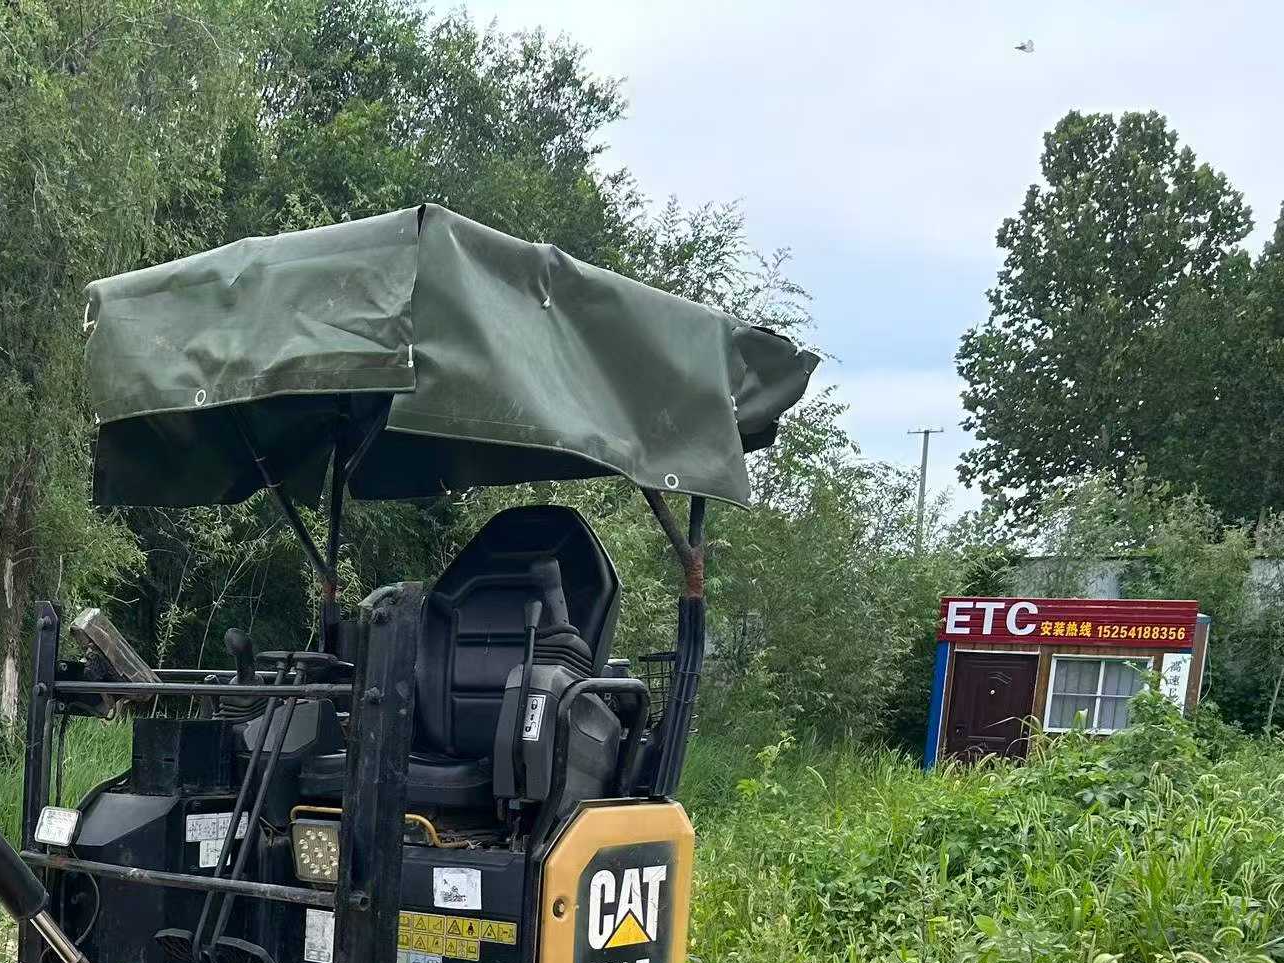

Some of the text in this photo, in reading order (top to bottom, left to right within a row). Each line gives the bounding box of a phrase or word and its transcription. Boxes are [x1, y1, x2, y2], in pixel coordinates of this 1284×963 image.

[945, 601, 1038, 636] ETC
[1040, 621, 1186, 640] 安装热线 15254188356
[587, 865, 667, 950] CAT
